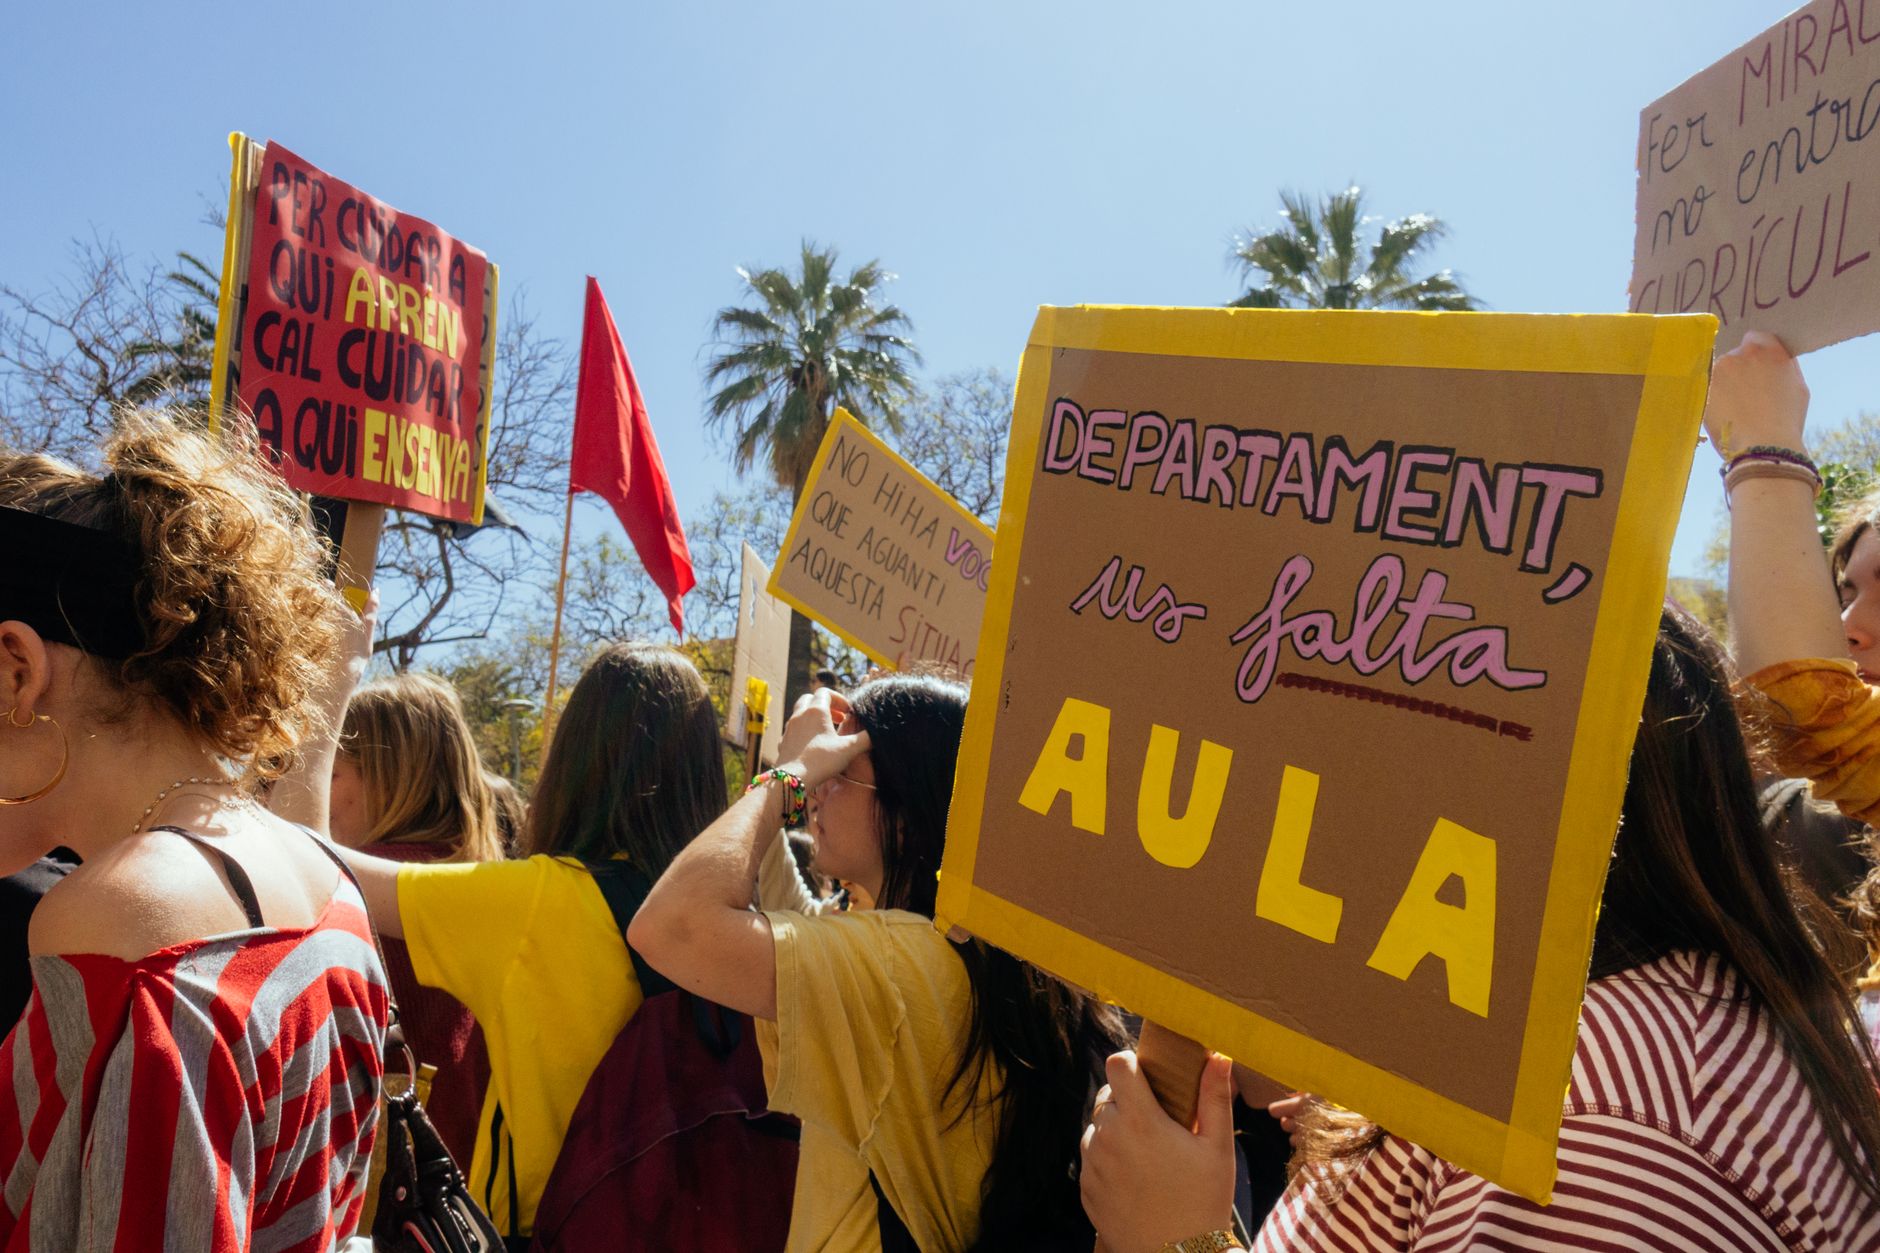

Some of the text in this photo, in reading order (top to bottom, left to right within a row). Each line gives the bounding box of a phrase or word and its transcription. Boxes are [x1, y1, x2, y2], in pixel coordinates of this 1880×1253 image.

[1647, 112, 1714, 184] Fer
[268, 161, 328, 248] PER
[448, 253, 466, 307] A
[1652, 184, 1717, 256] no
[253, 311, 321, 383] CAL
[252, 388, 283, 464] A
[362, 407, 471, 504] ENSENYA
[827, 435, 871, 488] NO
[811, 490, 853, 540] QUE
[1043, 398, 1604, 604] DEPARTAMENT,
[790, 537, 886, 621] AQUESTA
[1231, 553, 1548, 704] falta
[1018, 696, 1498, 1019] AULA
